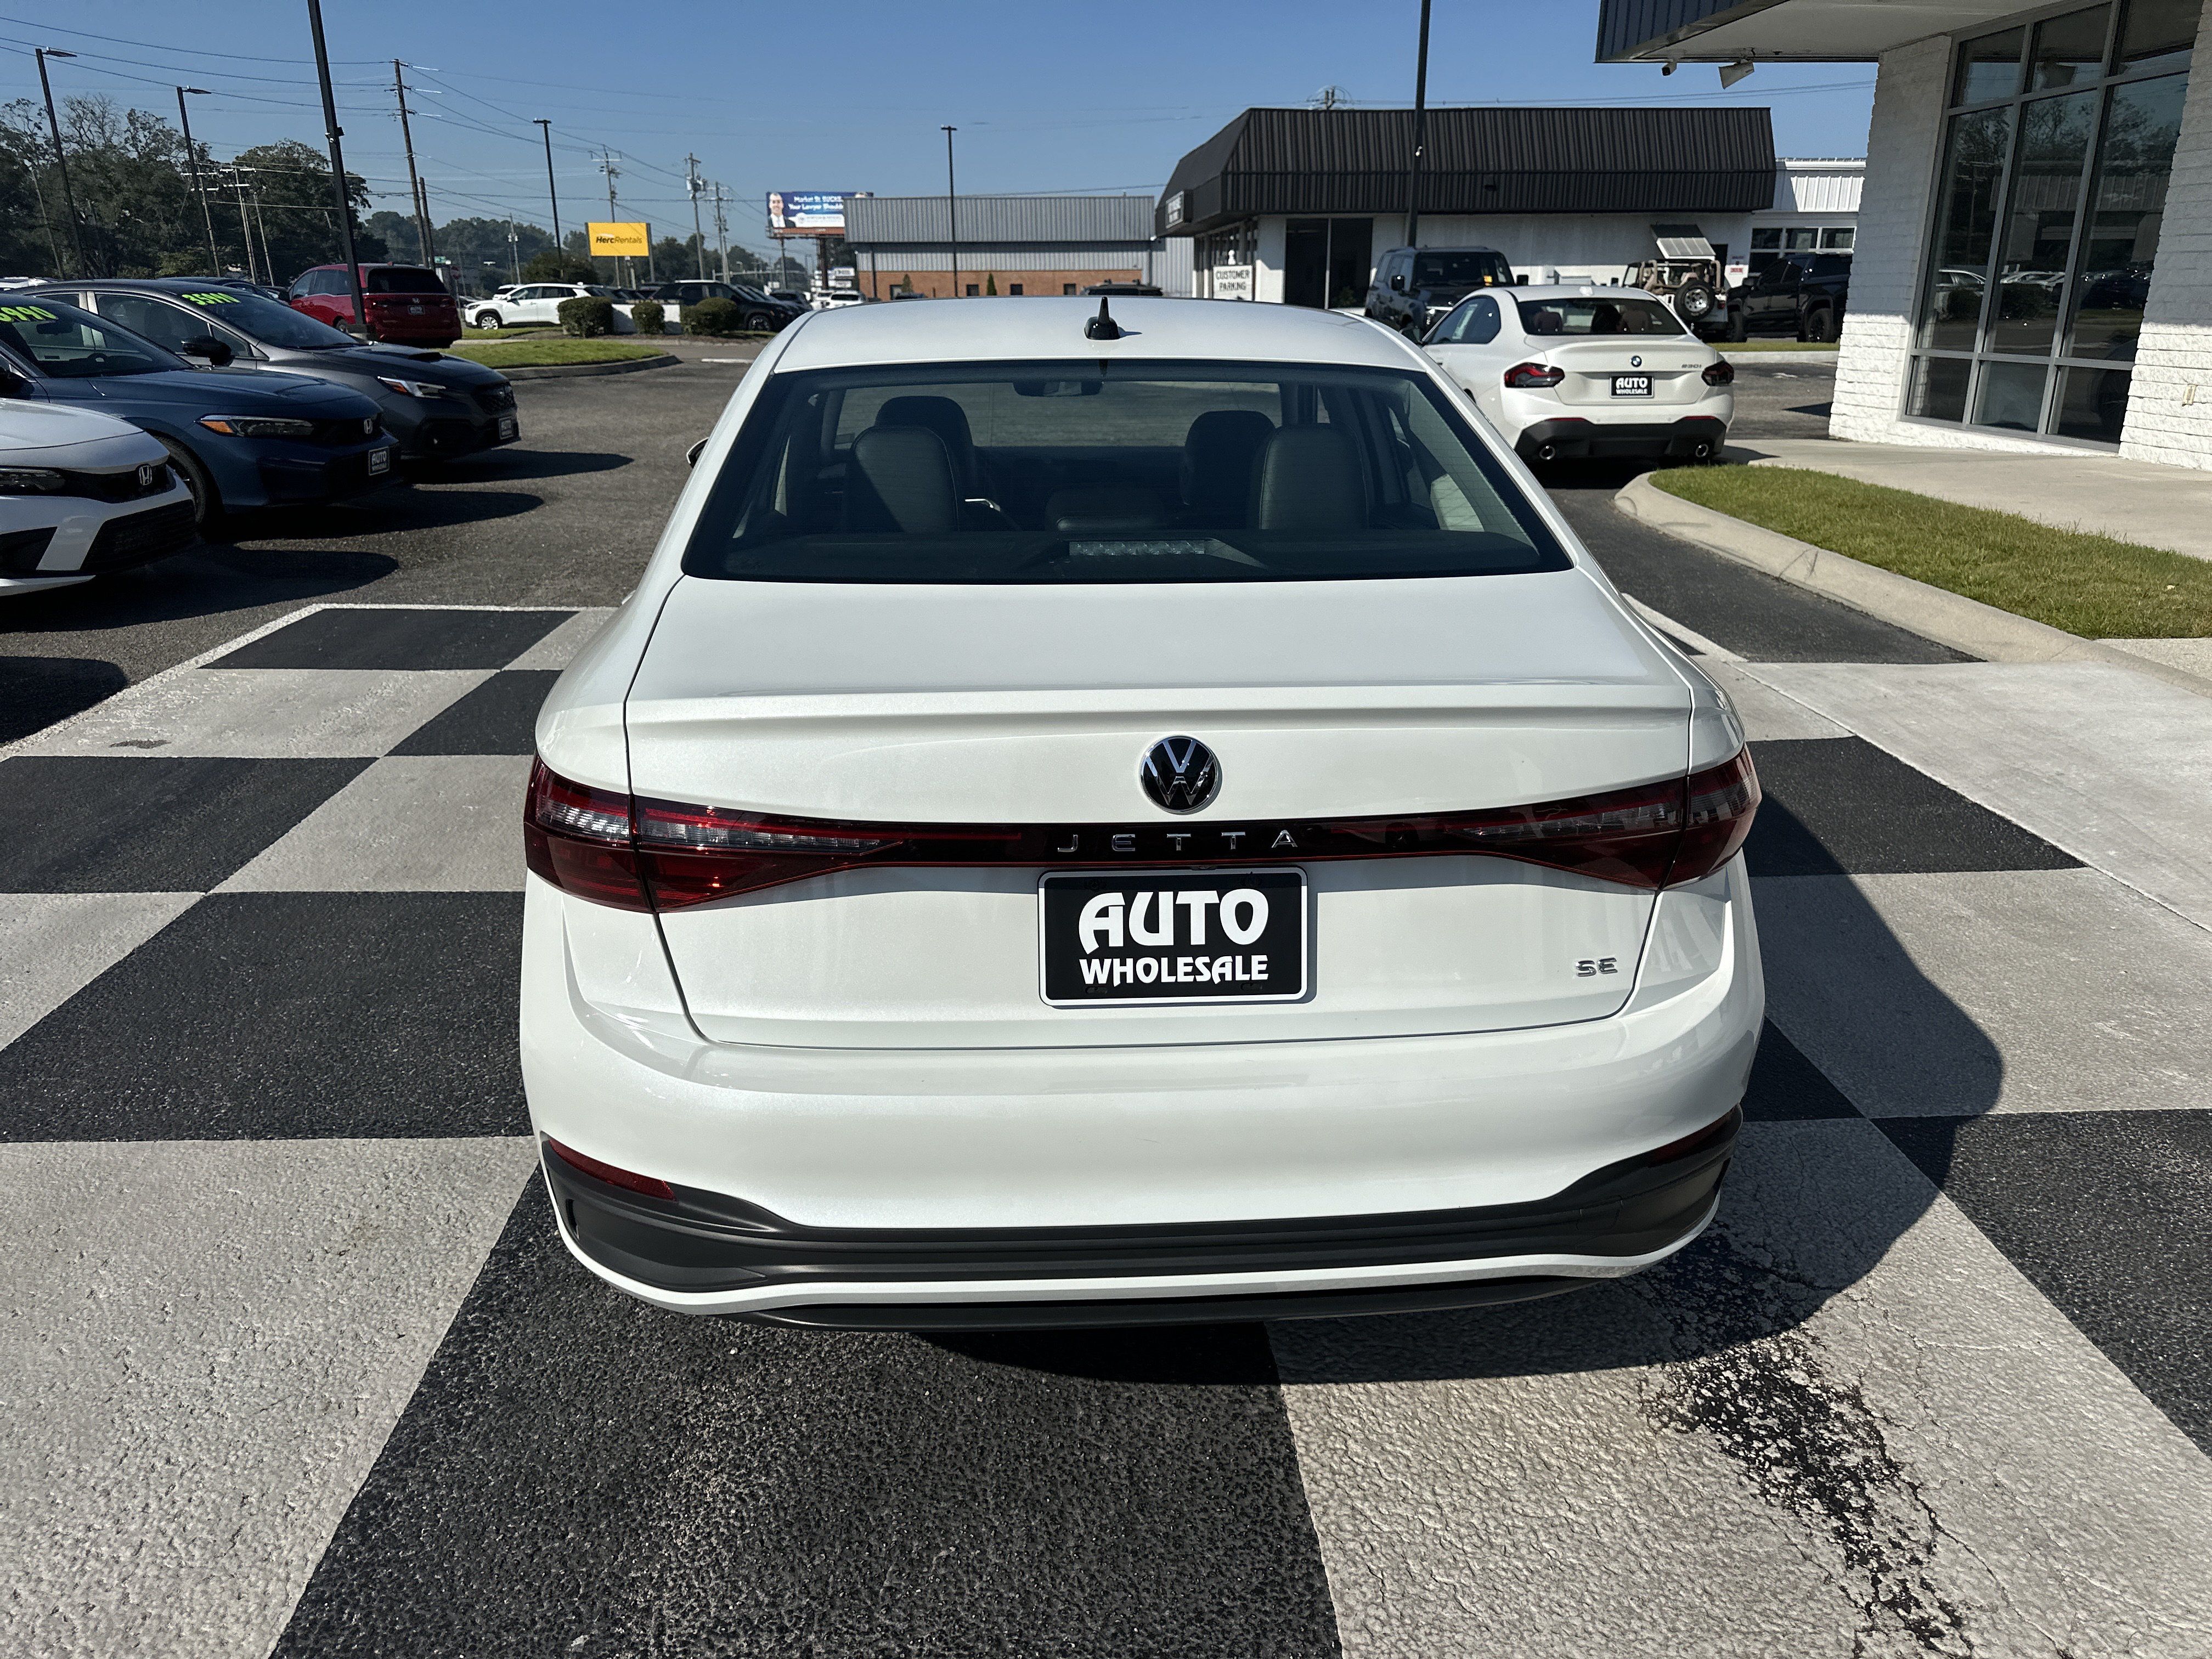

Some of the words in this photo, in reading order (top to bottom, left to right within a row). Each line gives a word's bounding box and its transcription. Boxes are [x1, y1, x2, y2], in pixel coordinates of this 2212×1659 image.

[595, 236, 642, 244] HercRentals
[1215, 269, 1250, 280] CUSTOMER
[1219, 281, 1247, 291] PARKING
[1615, 377, 1648, 389] AUTO
[1057, 829, 1298, 853] JETTA
[1078, 888, 1269, 955] AUTO
[1079, 955, 1269, 987] WHOLESALE
[1575, 957, 1618, 977] SE
